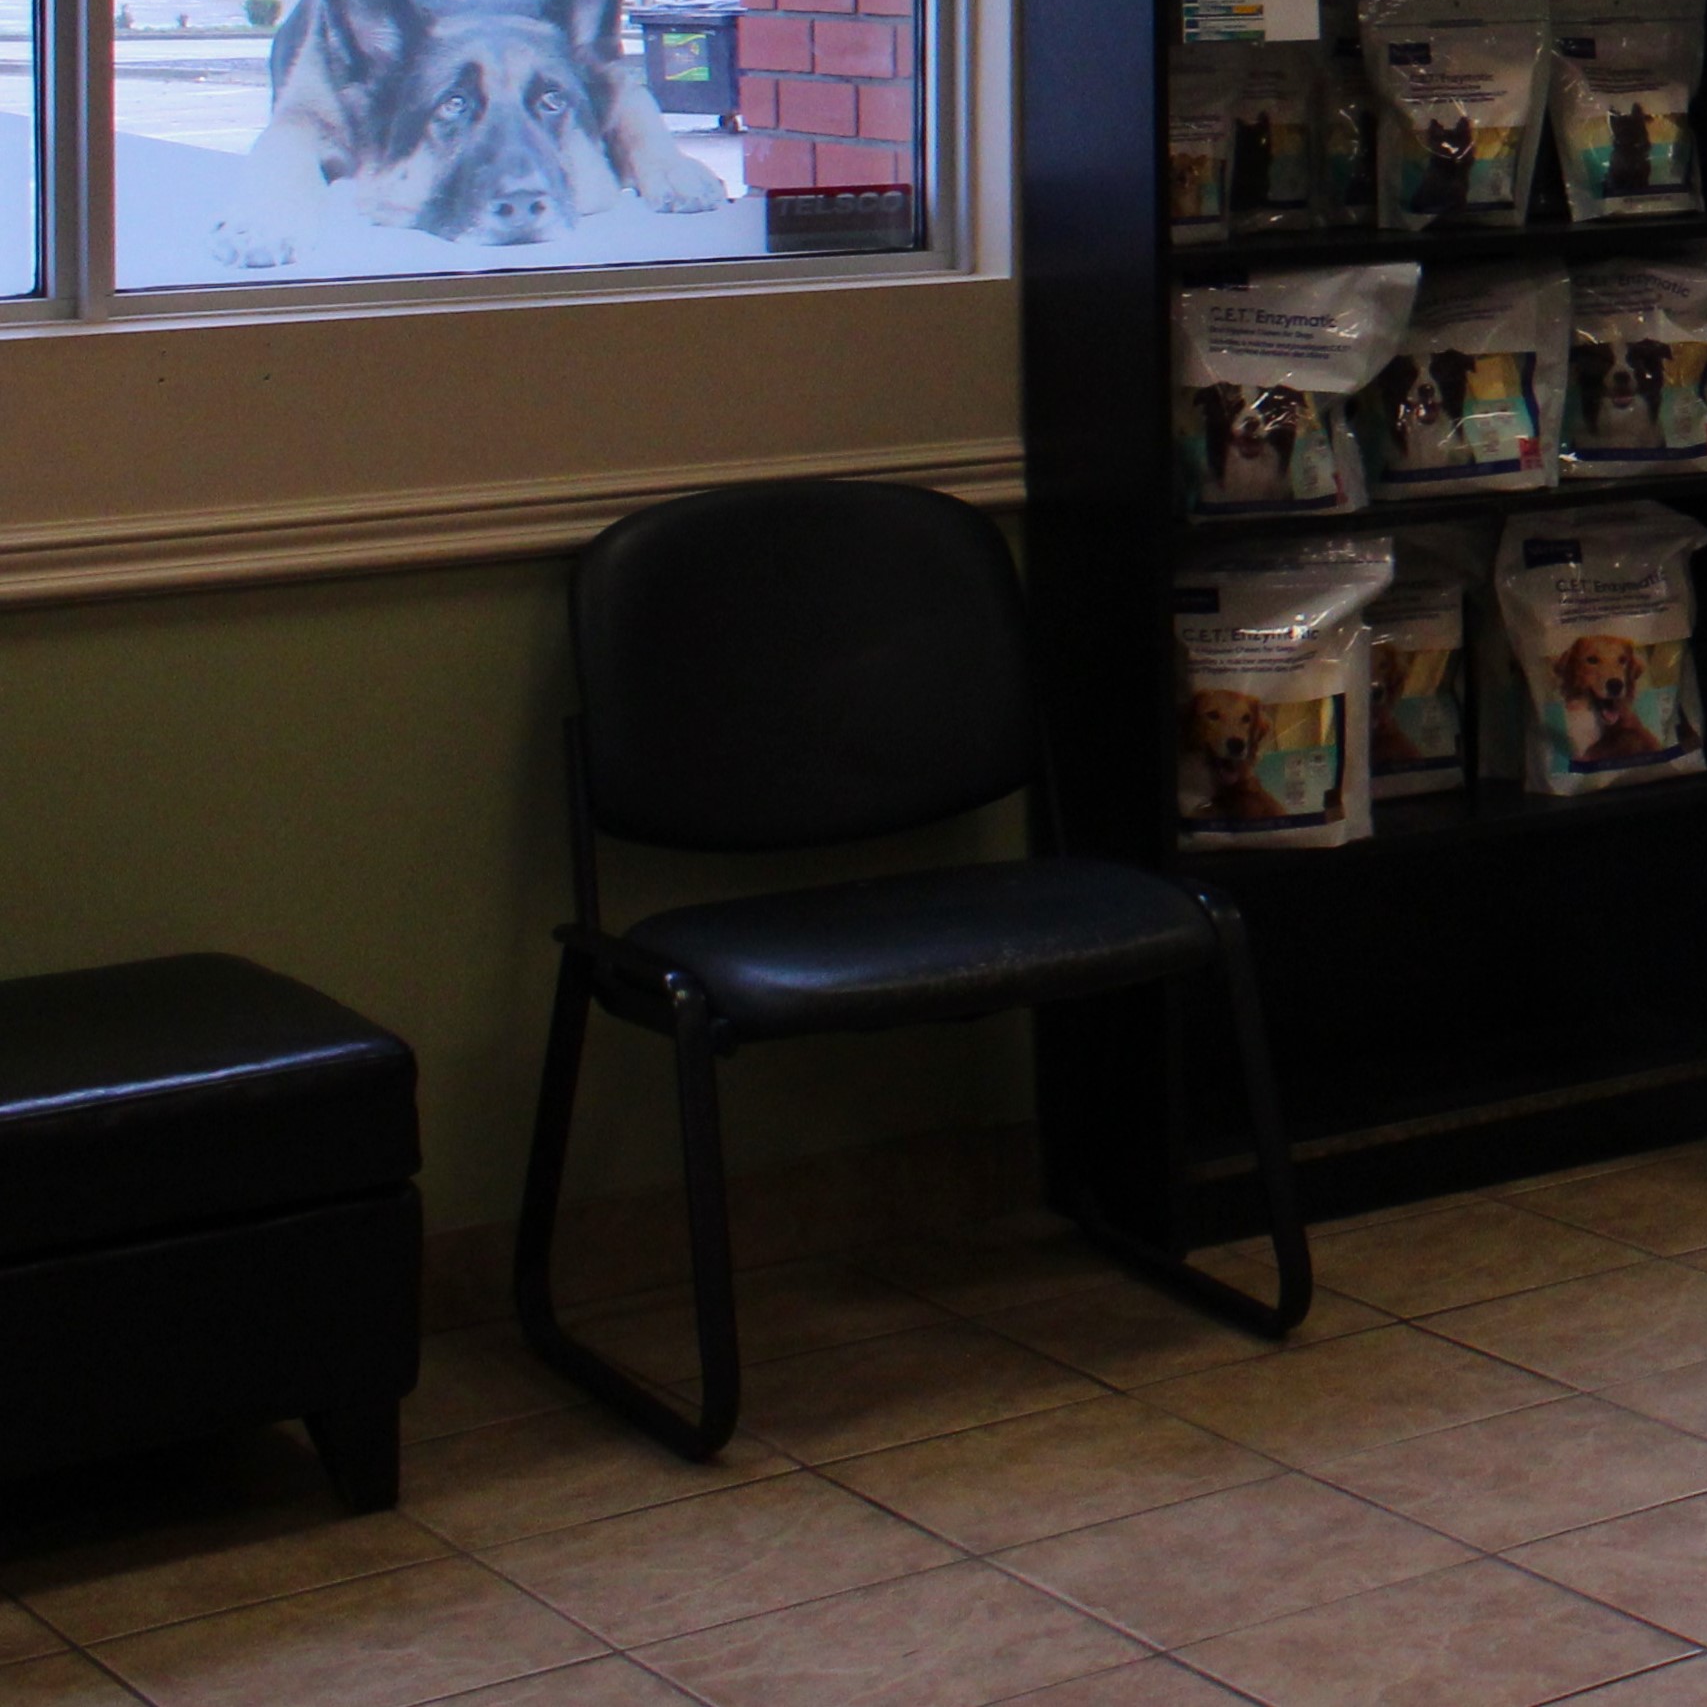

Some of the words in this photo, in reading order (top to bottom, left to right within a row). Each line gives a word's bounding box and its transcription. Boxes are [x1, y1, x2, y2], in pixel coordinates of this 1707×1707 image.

[775, 190, 904, 217] TELSCO
[1618, 273, 1691, 298] Enzymatic
[1210, 306, 1250, 323] C.E.T.
[1254, 308, 1338, 329] Enzymatic
